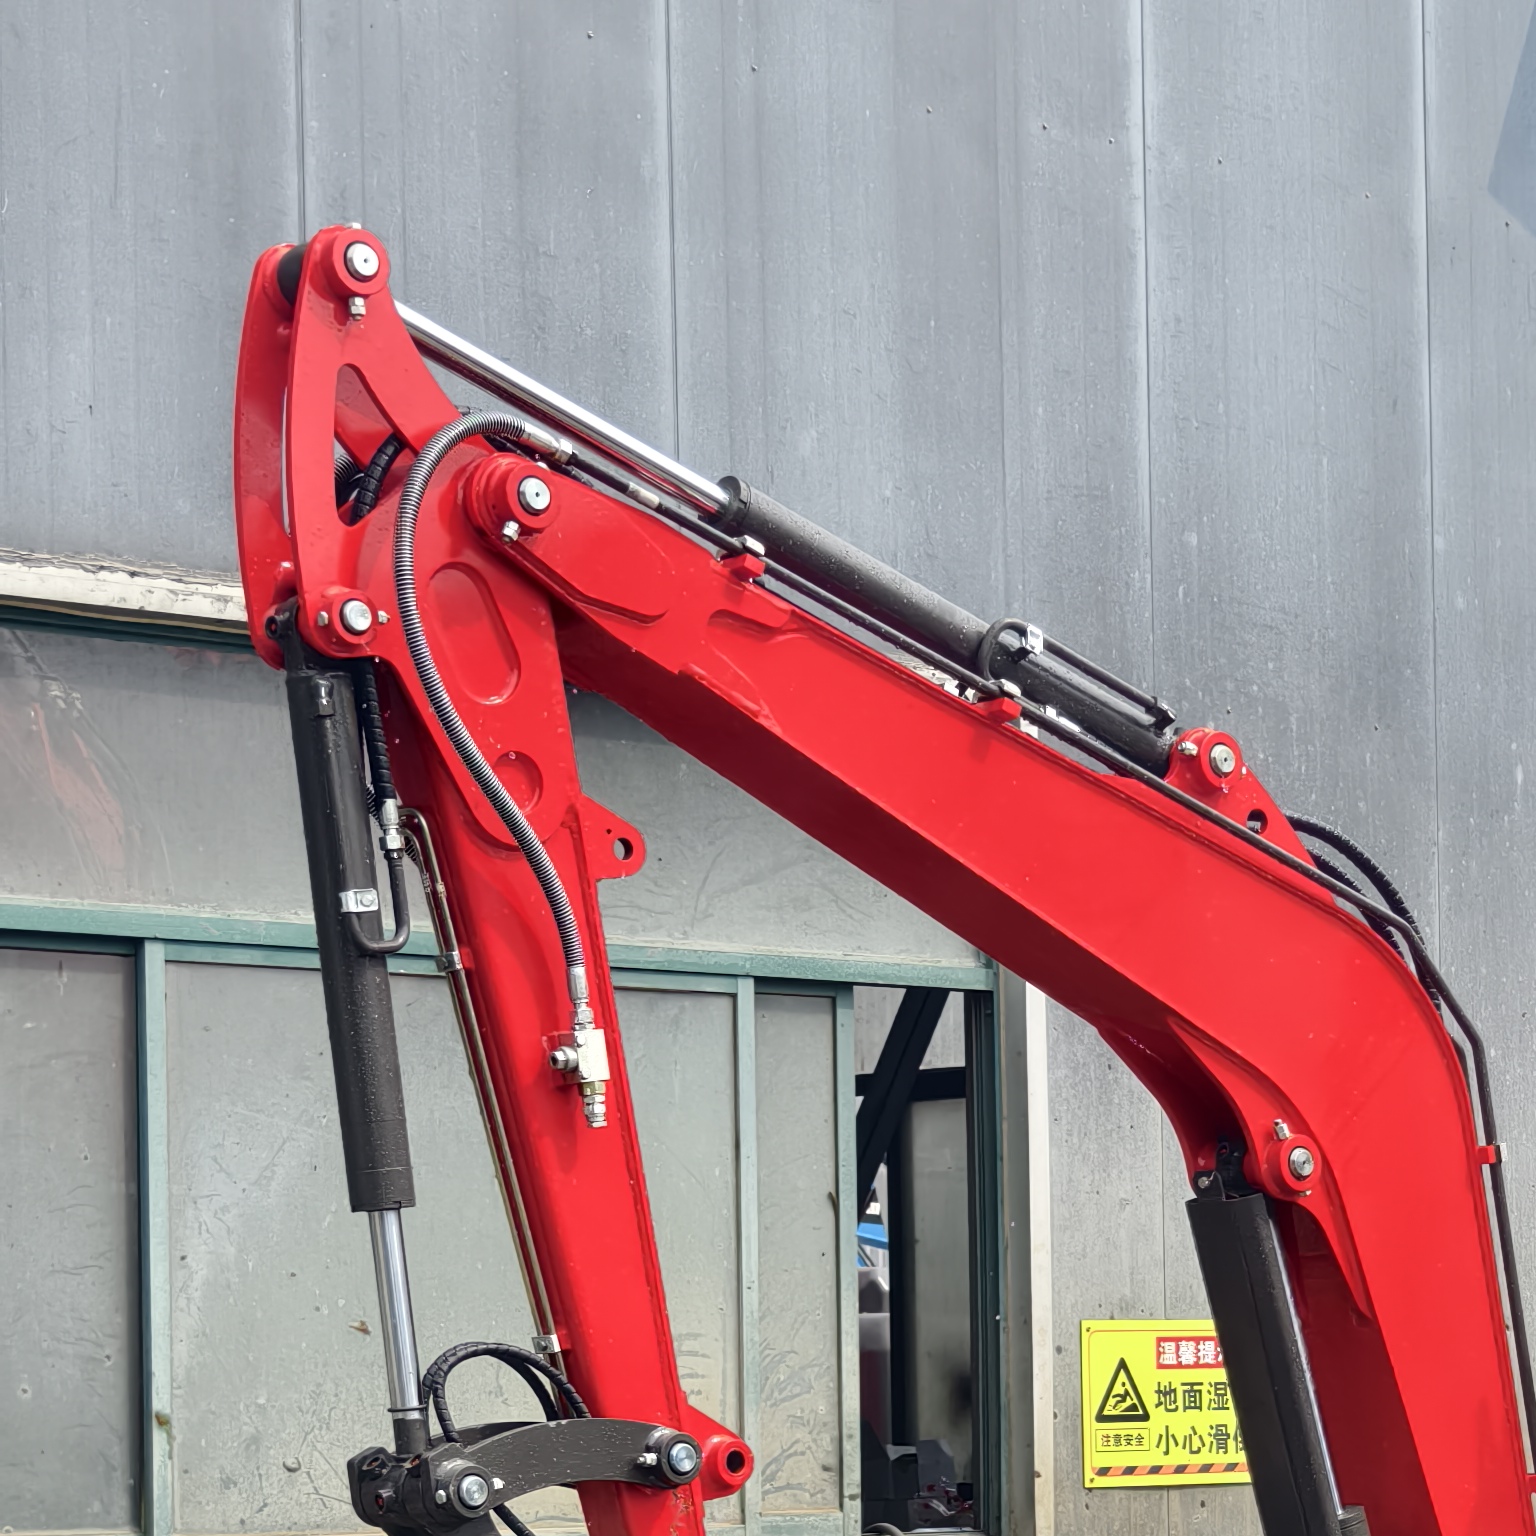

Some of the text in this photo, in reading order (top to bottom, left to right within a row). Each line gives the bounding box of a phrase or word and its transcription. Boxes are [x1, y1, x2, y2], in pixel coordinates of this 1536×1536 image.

[1158, 1341, 1222, 1365] 温馨提
[1100, 1433, 1145, 1447] 注意安全
